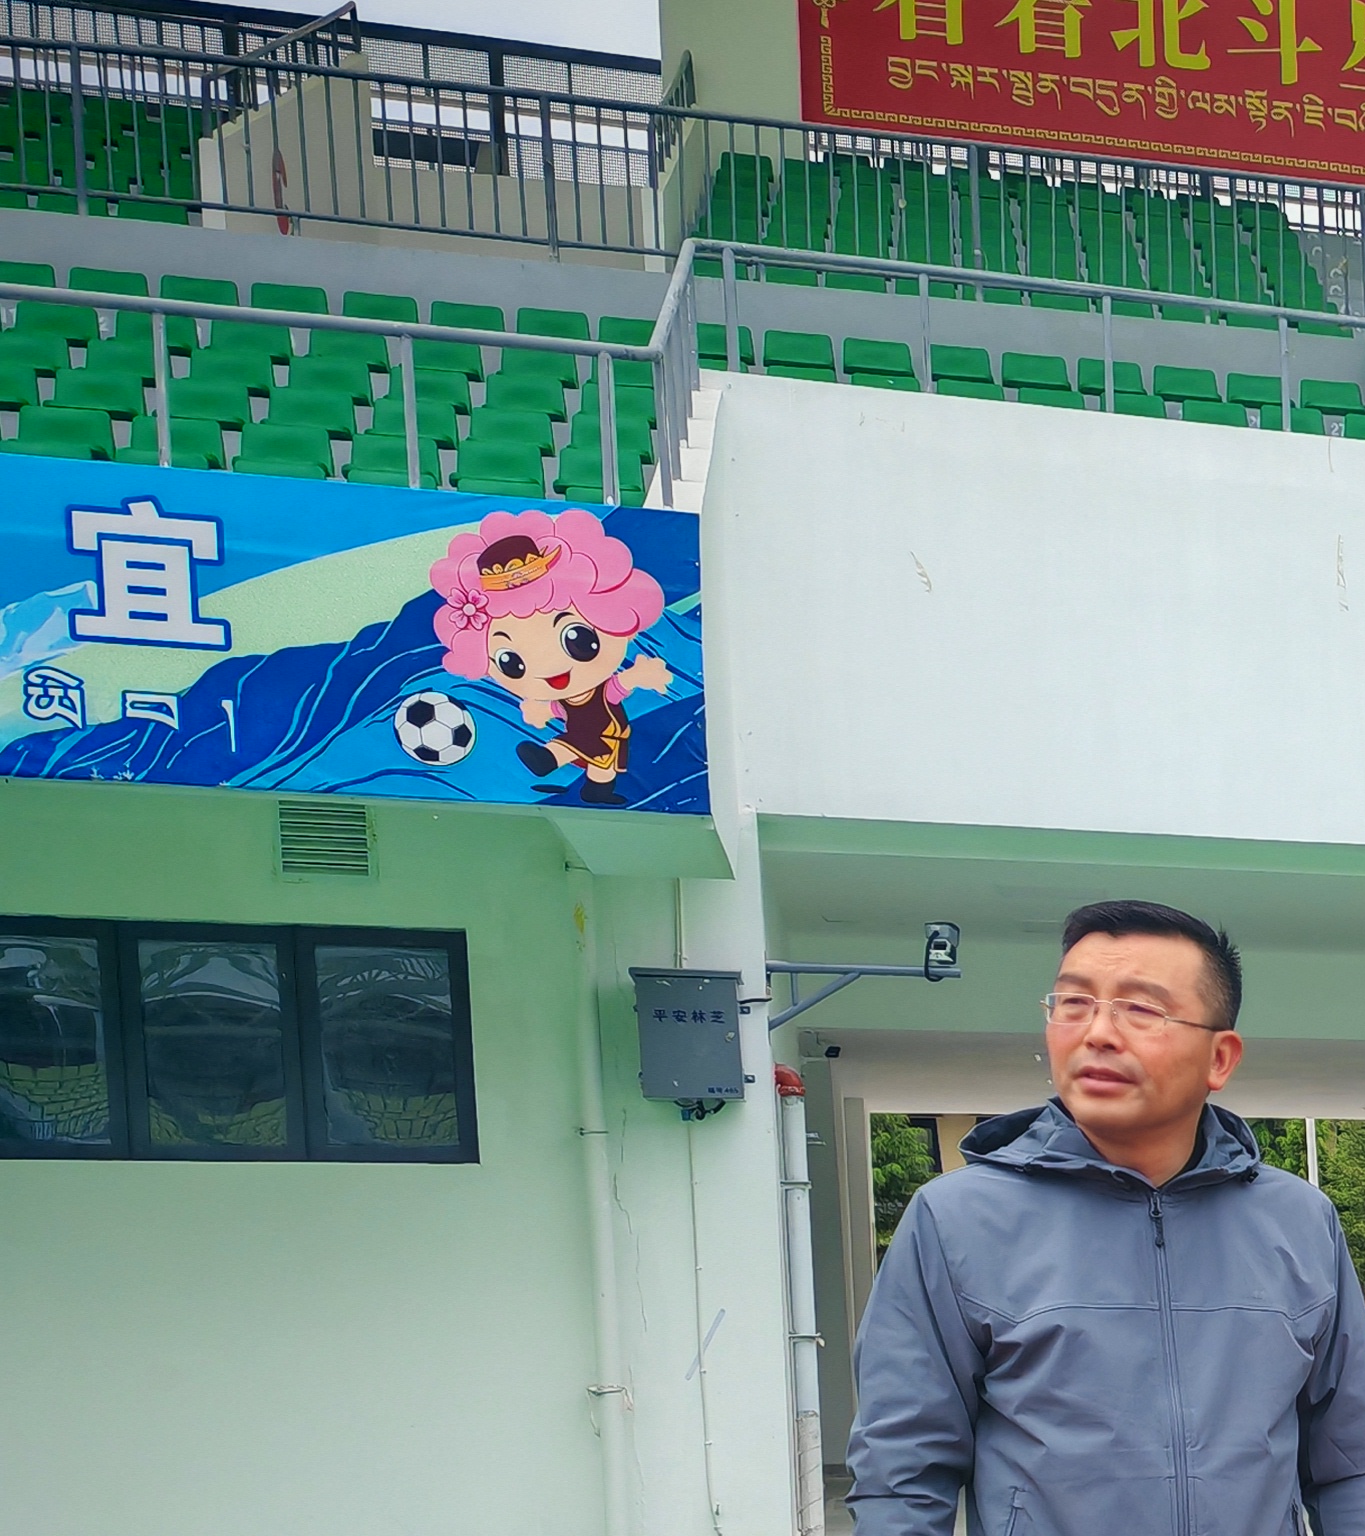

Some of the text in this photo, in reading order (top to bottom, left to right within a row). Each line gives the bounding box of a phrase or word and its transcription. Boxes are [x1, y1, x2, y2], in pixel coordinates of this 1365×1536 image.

[68, 497, 231, 650] 宜
[653, 1008, 725, 1024] 平安林芝
